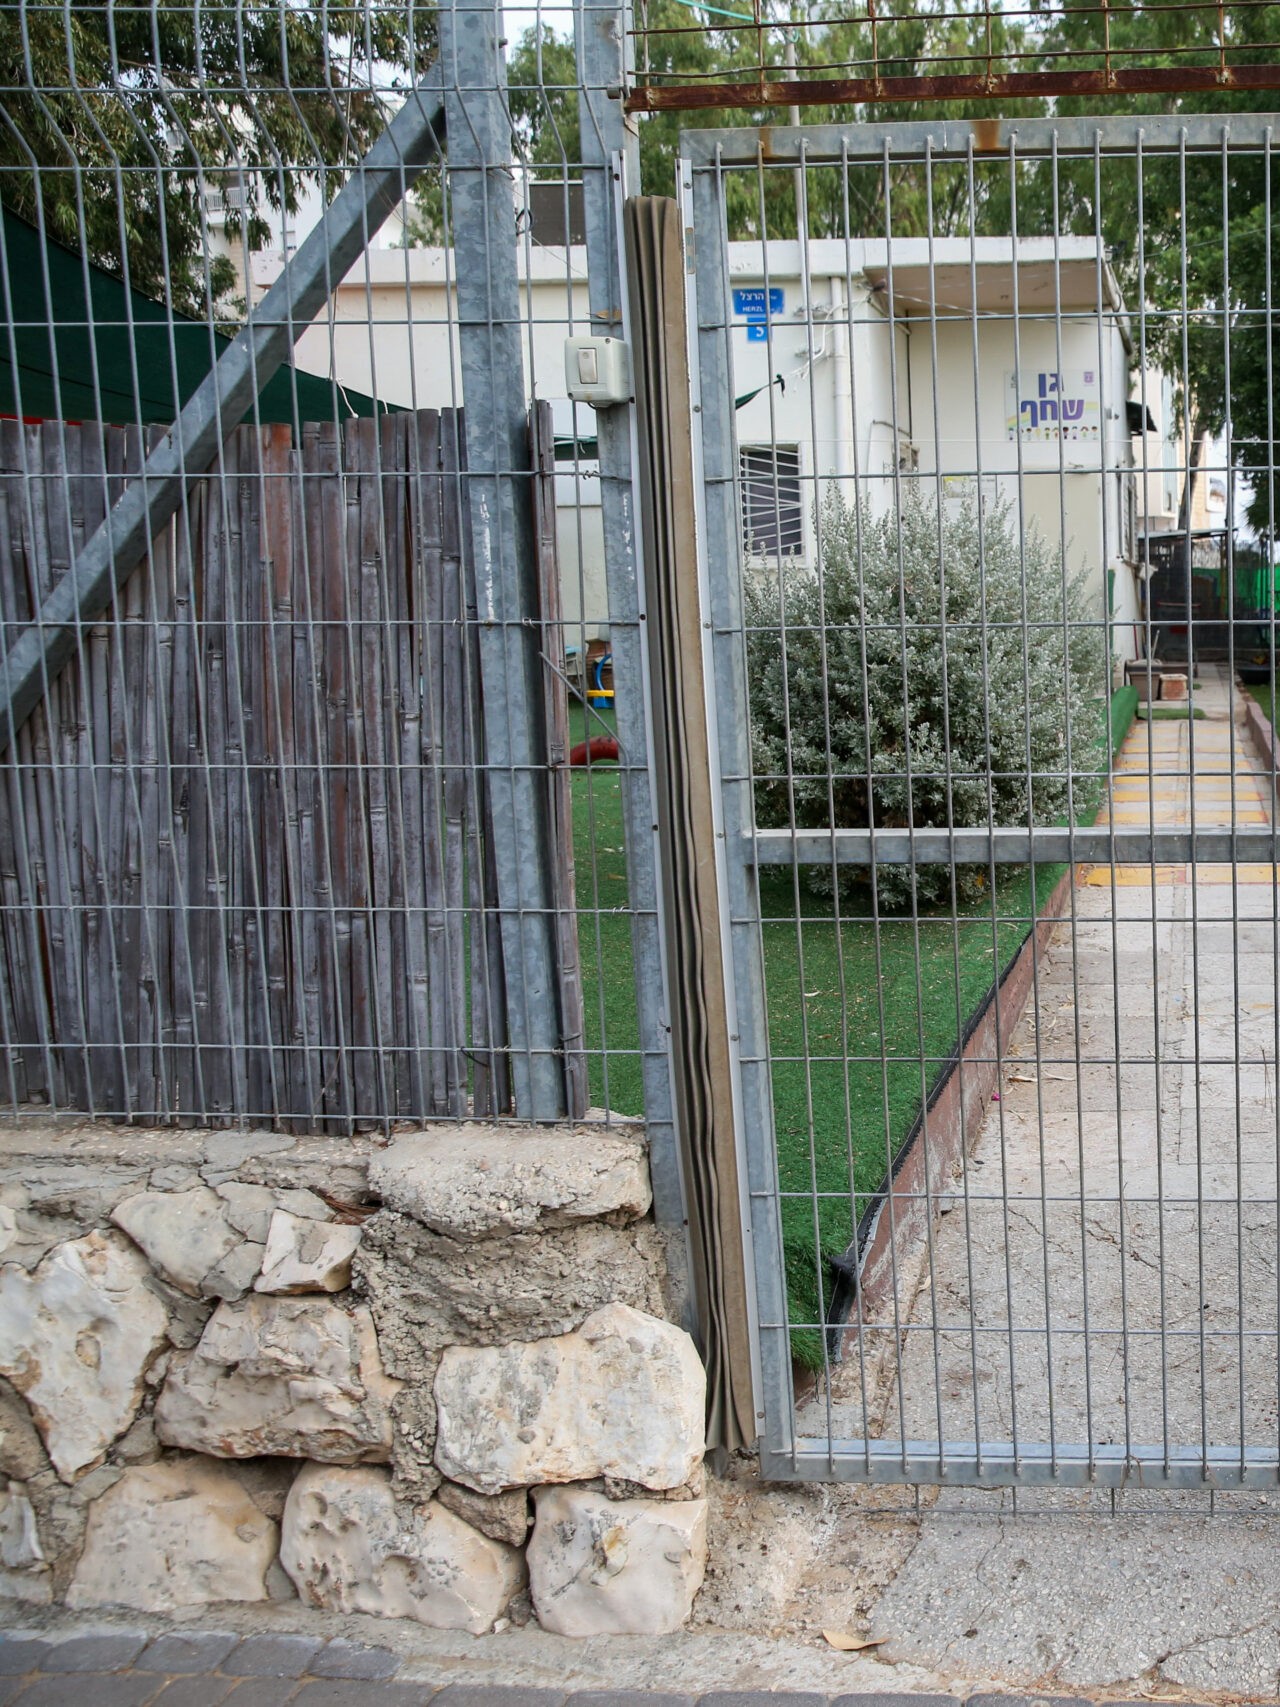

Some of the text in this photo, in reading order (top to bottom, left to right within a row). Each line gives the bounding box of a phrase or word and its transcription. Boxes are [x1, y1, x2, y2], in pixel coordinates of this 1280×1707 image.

[740, 291, 764, 300] הרצל
[1038, 373, 1064, 398] גן
[1020, 400, 1084, 428] שחף
